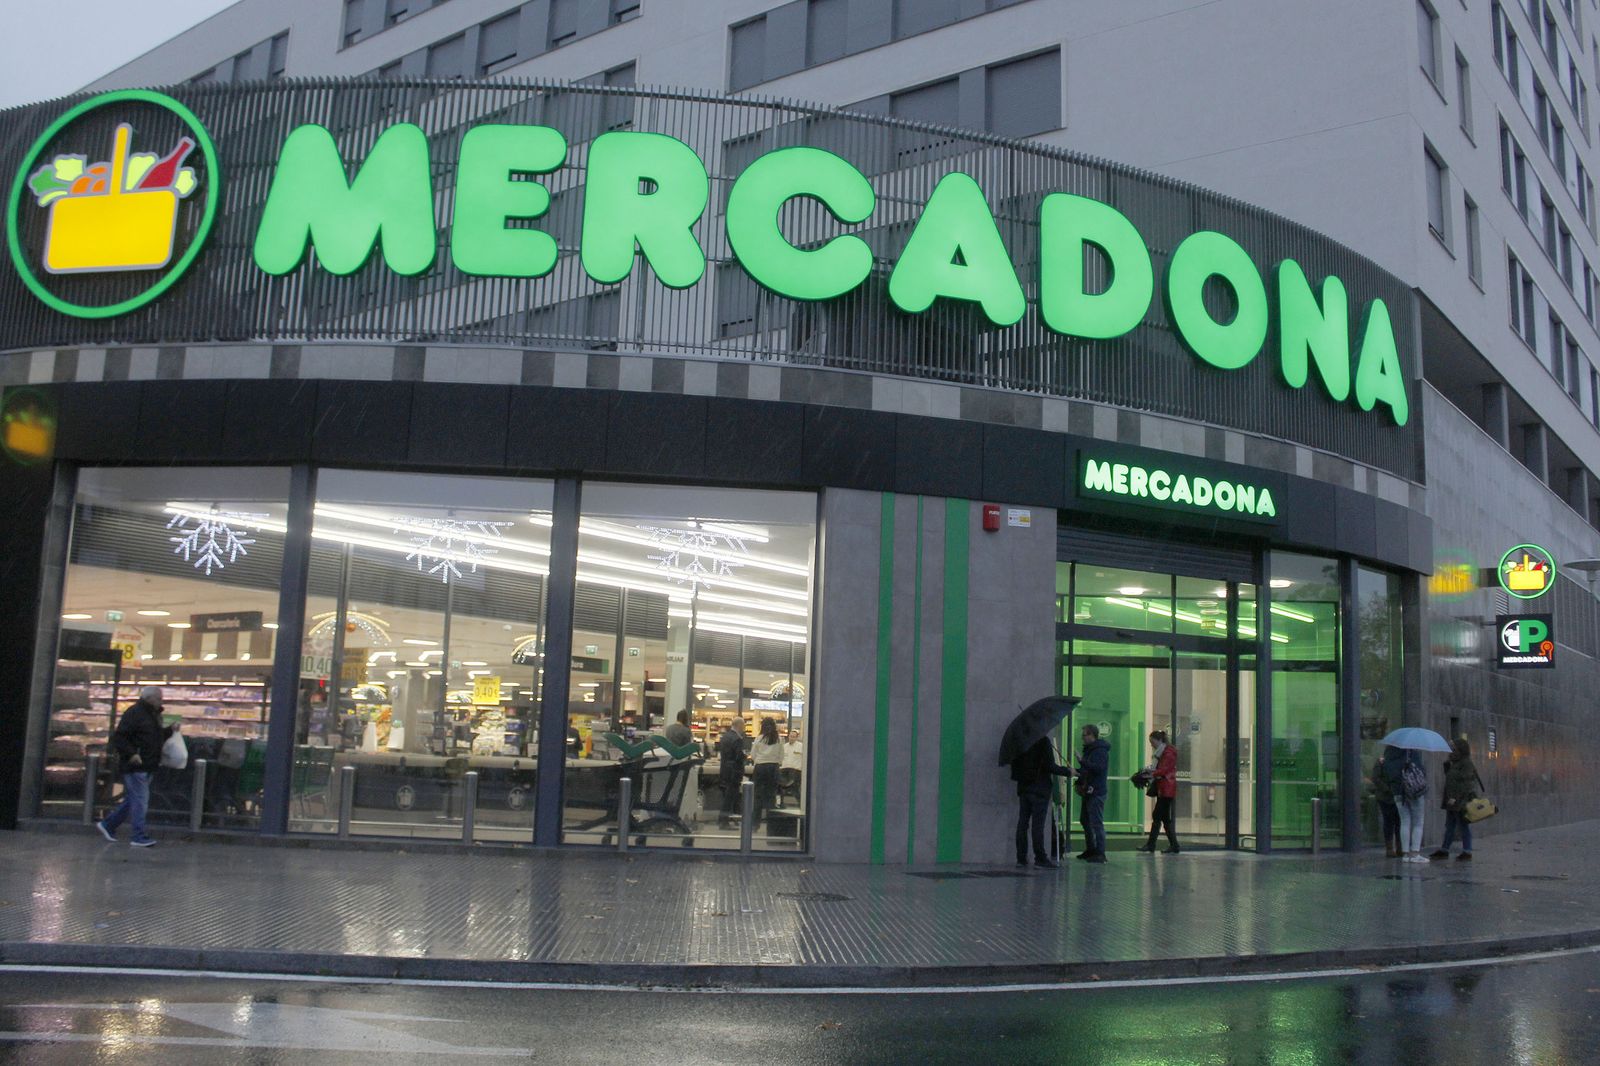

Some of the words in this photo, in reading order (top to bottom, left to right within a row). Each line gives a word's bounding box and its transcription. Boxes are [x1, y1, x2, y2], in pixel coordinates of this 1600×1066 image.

[254, 123, 1409, 426] MERCADONA
[1084, 459, 1276, 517] MERCADONA
[1519, 619, 1548, 652] P
